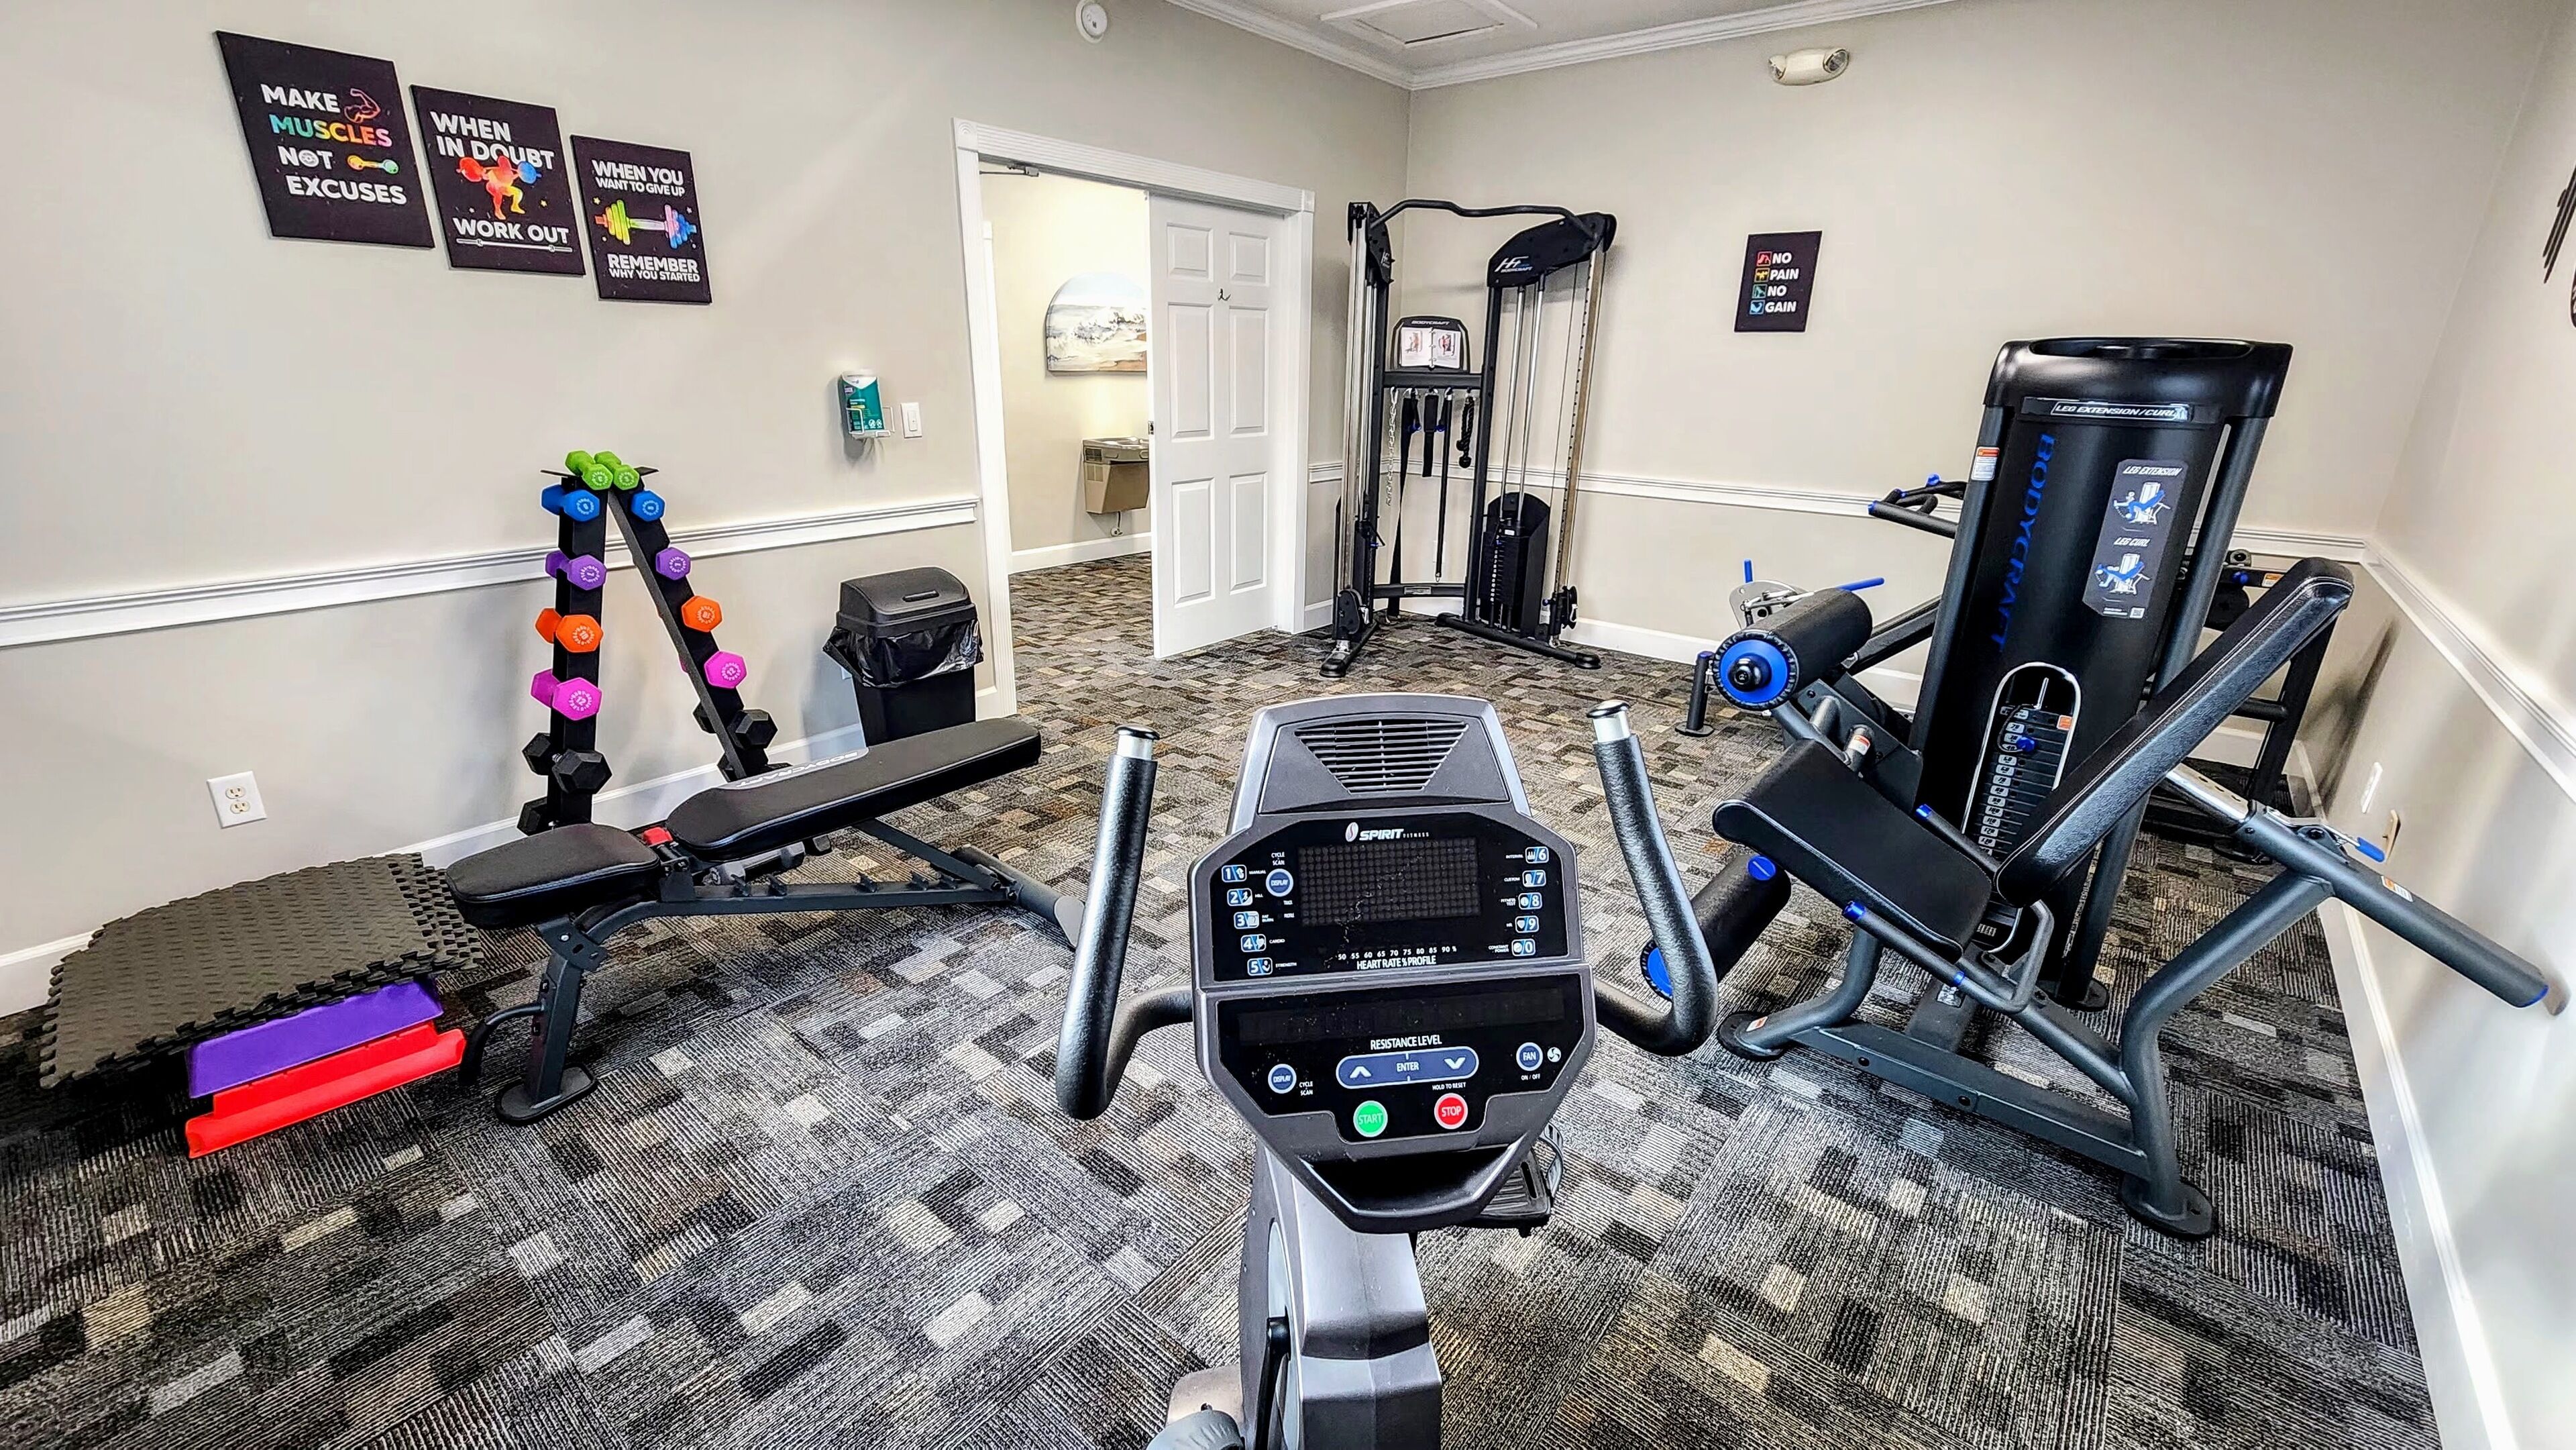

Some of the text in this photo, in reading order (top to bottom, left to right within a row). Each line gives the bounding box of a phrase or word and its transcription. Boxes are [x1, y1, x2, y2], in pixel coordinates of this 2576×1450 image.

[260, 84, 340, 113] MAKE
[268, 114, 392, 147] MUSCLES
[430, 111, 511, 142] WHEN
[277, 146, 333, 169] NOT
[436, 136, 554, 170] IN DOUBT
[592, 160, 684, 186] WHEN YOU
[285, 175, 407, 205] EXCUSES
[595, 176, 686, 197] WANT TO GIVE UP
[453, 218, 569, 244] WORK OUT
[607, 254, 699, 273] REMEMBER
[1772, 252, 1792, 264] NO
[608, 268, 700, 282] WHY YOU STARTED
[1770, 268, 1799, 280] PAIN
[1767, 285, 1787, 297] NO
[1764, 301, 1796, 313] GAIN
[2123, 466, 2182, 476] LEG EXTENSION
[1991, 434, 2055, 653] BODYCRAFT
[2114, 537, 2150, 547] LEG CURL
[576, 696, 586, 706] 12
[736, 752, 857, 787] BODYCRAFT
[1359, 829, 1404, 841] SPIRIT
[1538, 849, 1546, 860] 6
[1225, 868, 1231, 880] 1
[1536, 872, 1544, 884] 7
[1230, 891, 1239, 904] 2
[1532, 895, 1540, 907] 8
[1236, 915, 1244, 927] 3
[1528, 918, 1536, 930] 9
[1243, 938, 1252, 949] 4
[1525, 941, 1533, 953] 0
[1250, 961, 1258, 973] 5
[1356, 959, 1382, 970] HEART
[1382, 957, 1401, 968] RATE
[1408, 955, 1436, 966] PROFILE
[1371, 1034, 1442, 1050] RESISTANCE LEVEL
[1523, 1052, 1536, 1061] FAN
[1396, 1062, 1419, 1072] ENTER
[1273, 1075, 1291, 1083] DISPLAY
[1442, 1106, 1462, 1117] STOP
[1358, 1113, 1383, 1125] START
